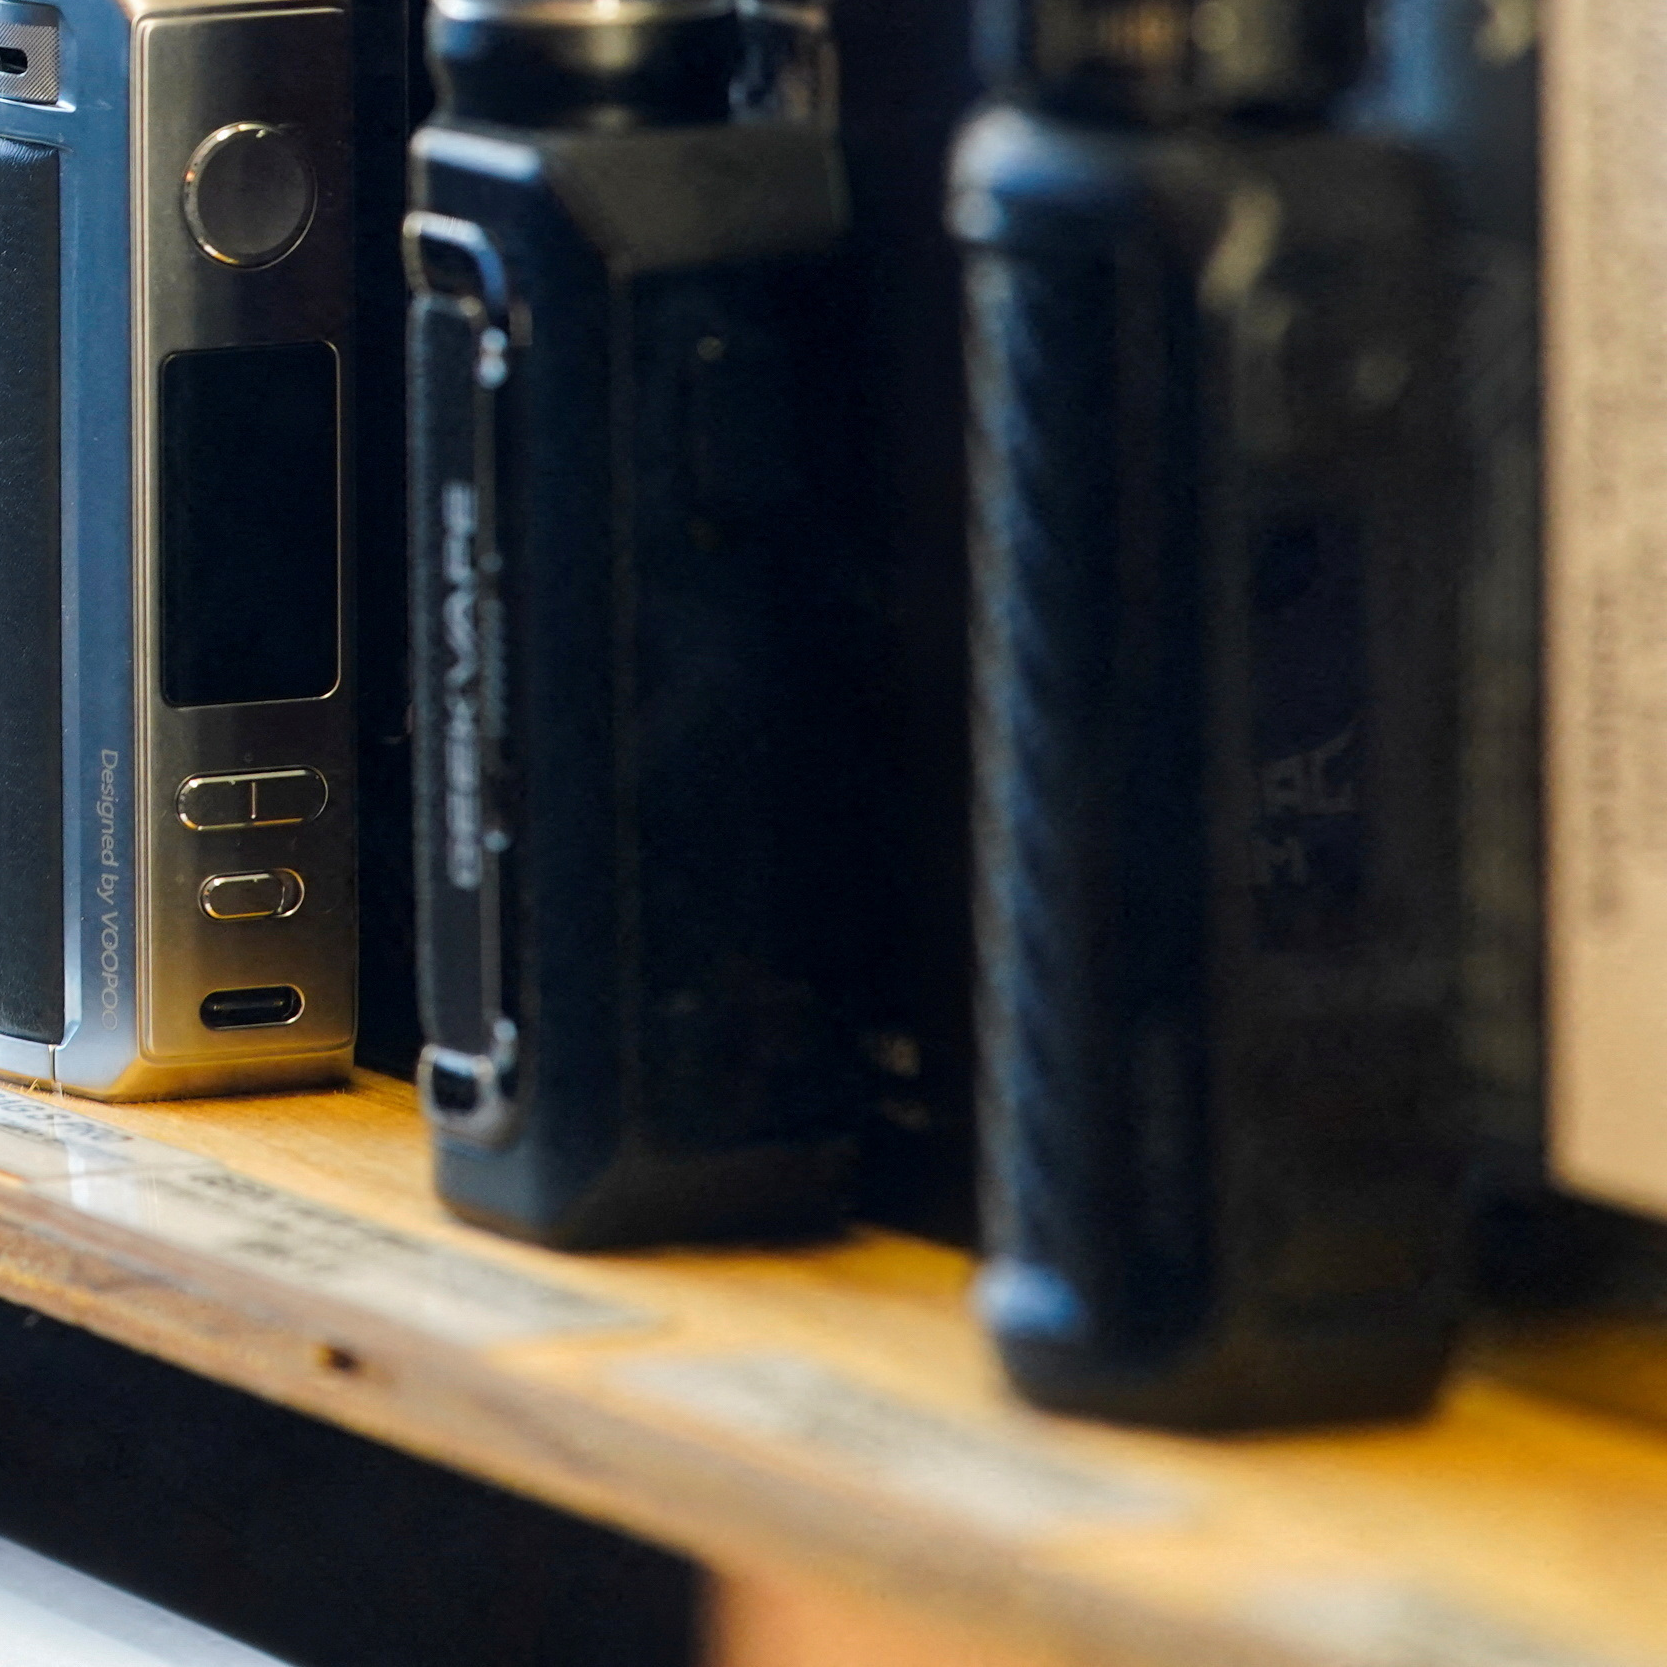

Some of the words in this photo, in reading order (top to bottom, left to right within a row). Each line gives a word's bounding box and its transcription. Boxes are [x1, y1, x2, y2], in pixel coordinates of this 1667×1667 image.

[97, 748, 120, 868] Designed
[97, 874, 120, 906] by
[100, 911, 120, 1032] VOOPOO
